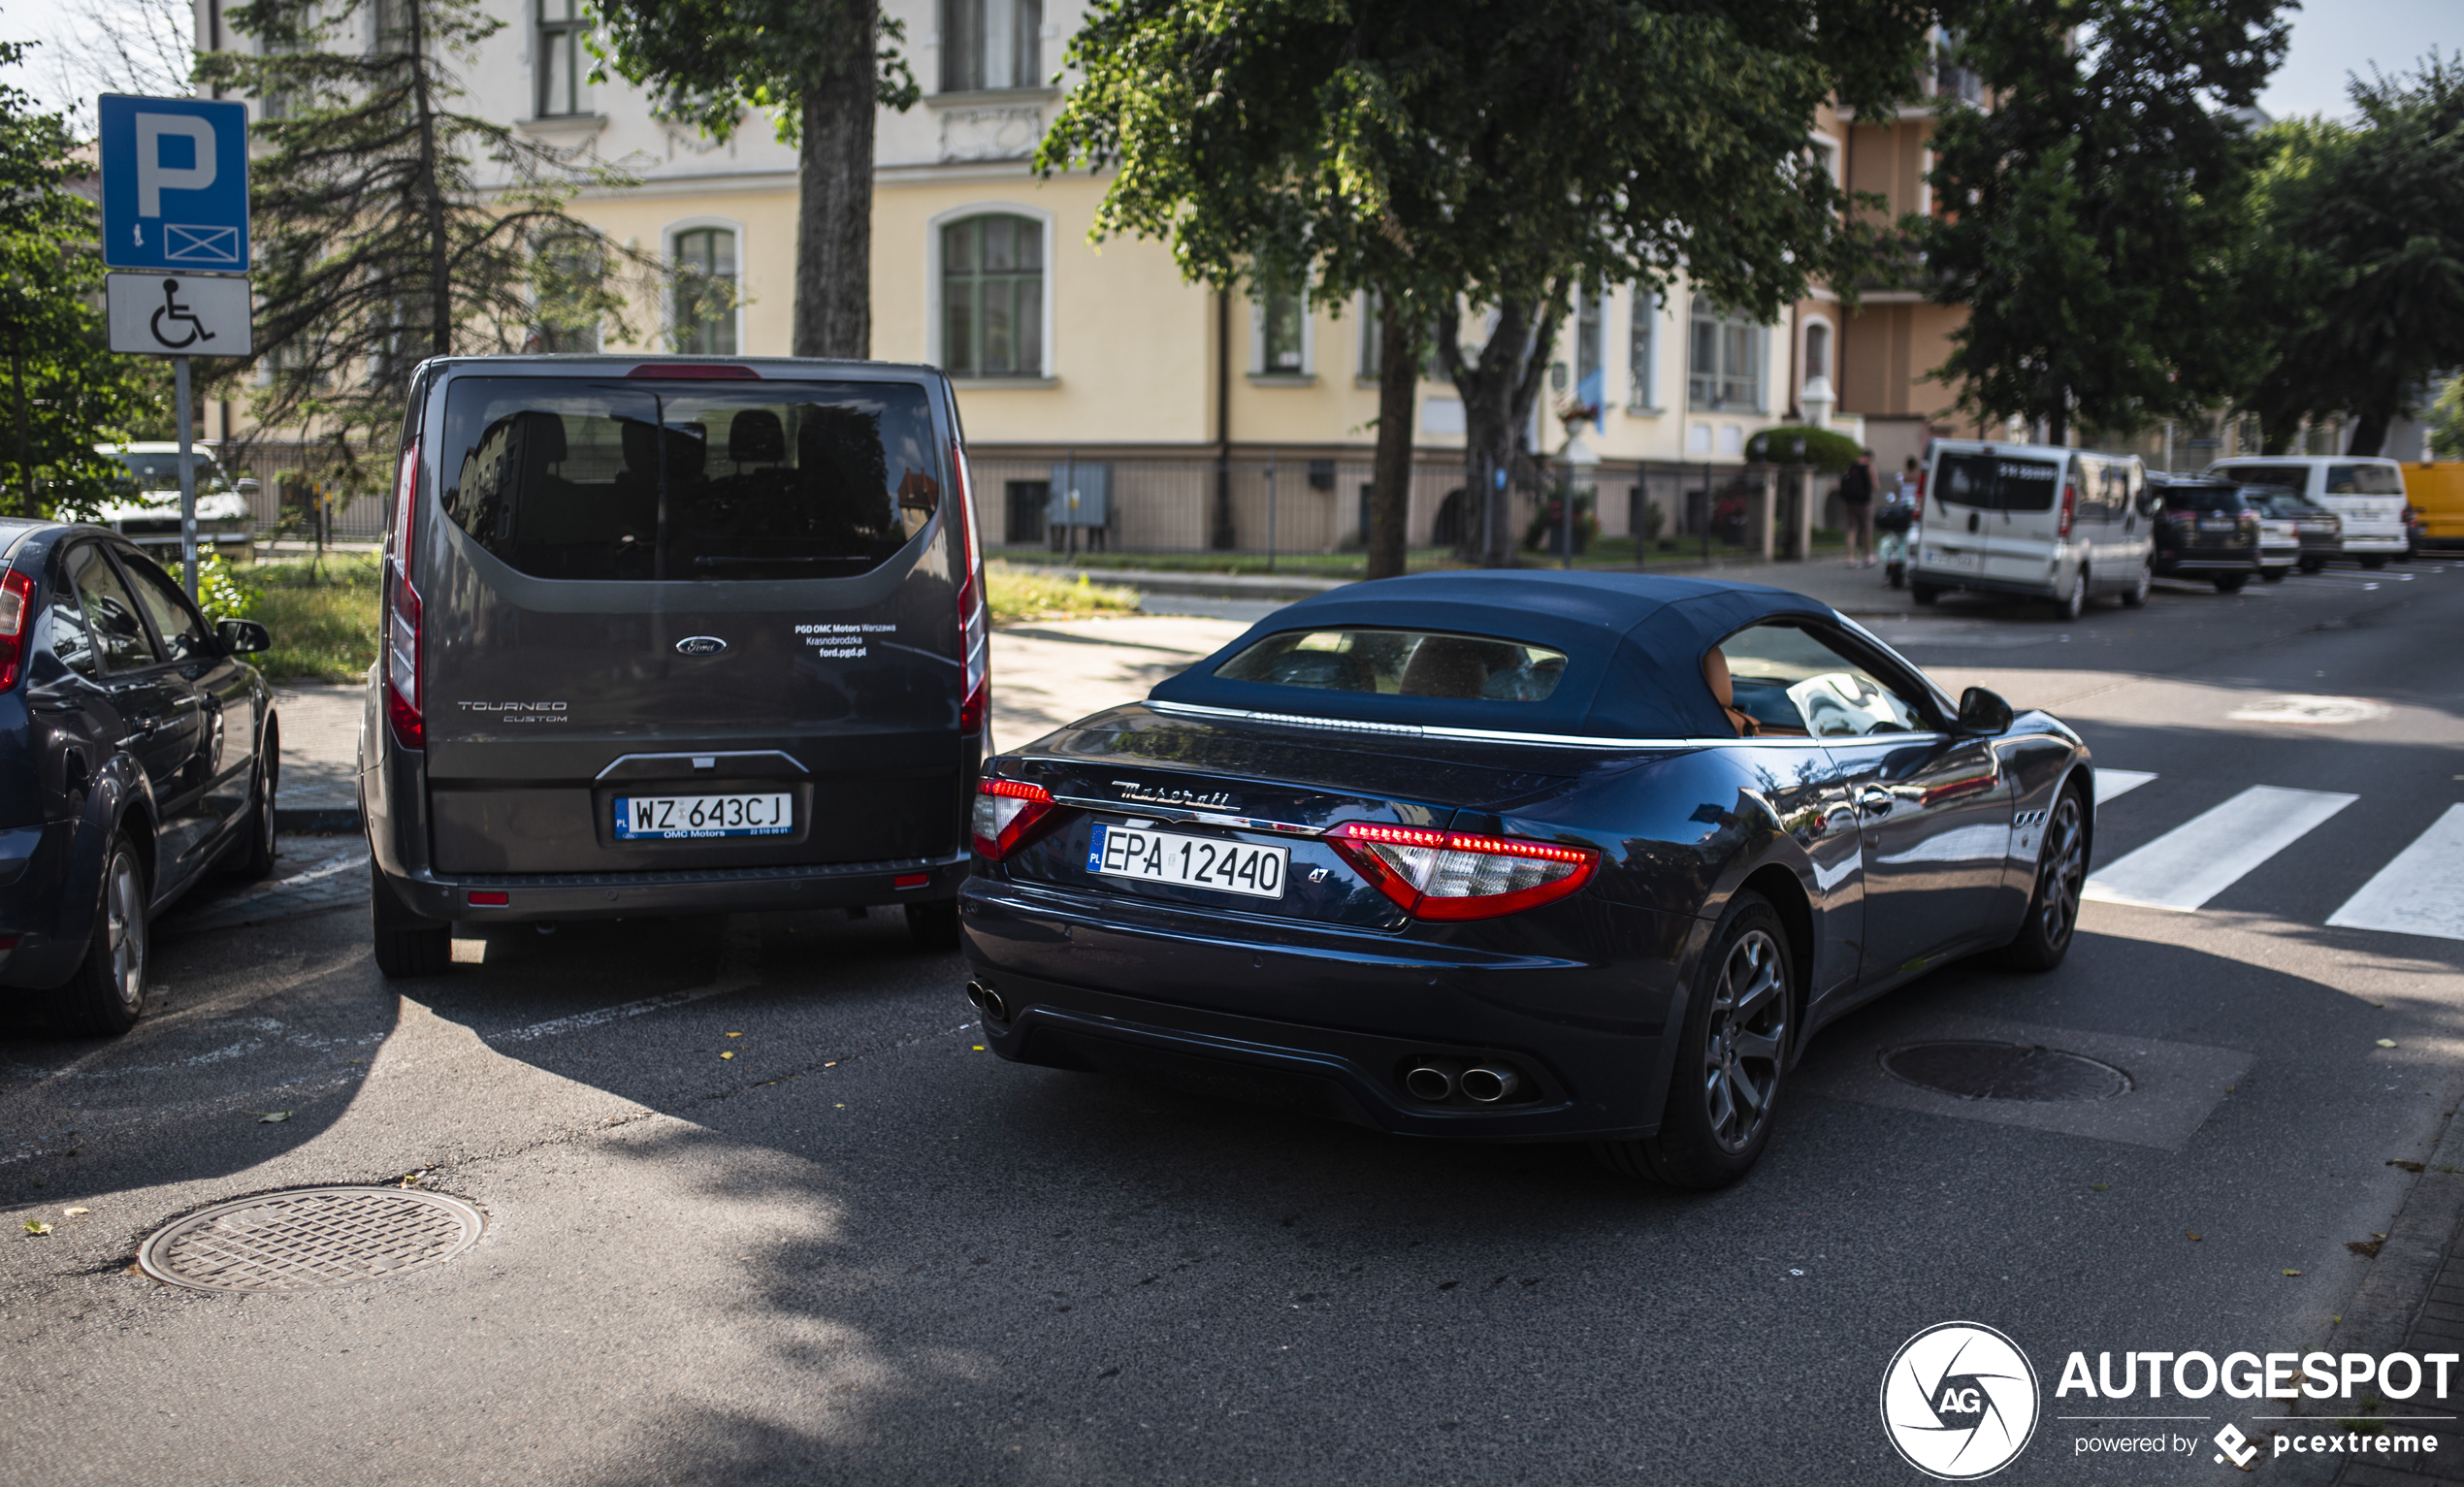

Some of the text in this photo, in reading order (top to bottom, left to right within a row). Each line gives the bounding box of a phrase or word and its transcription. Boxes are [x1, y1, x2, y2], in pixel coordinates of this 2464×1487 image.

[136, 113, 217, 218] P
[795, 623, 896, 633] PGD OMC Motors Warszawa
[806, 635, 862, 646] Krasnobrodzka
[819, 647, 866, 658] ford.pgd.pl
[458, 701, 567, 711] TOURNEO
[1112, 781, 1241, 811] Maserati
[636, 796, 780, 829] WZ 643CJ
[616, 819, 628, 828] PL
[664, 829, 726, 839] OMC Motors
[1089, 853, 1100, 864] PL
[1104, 831, 1280, 890] EPA 12440
[1309, 868, 1328, 883] 47
